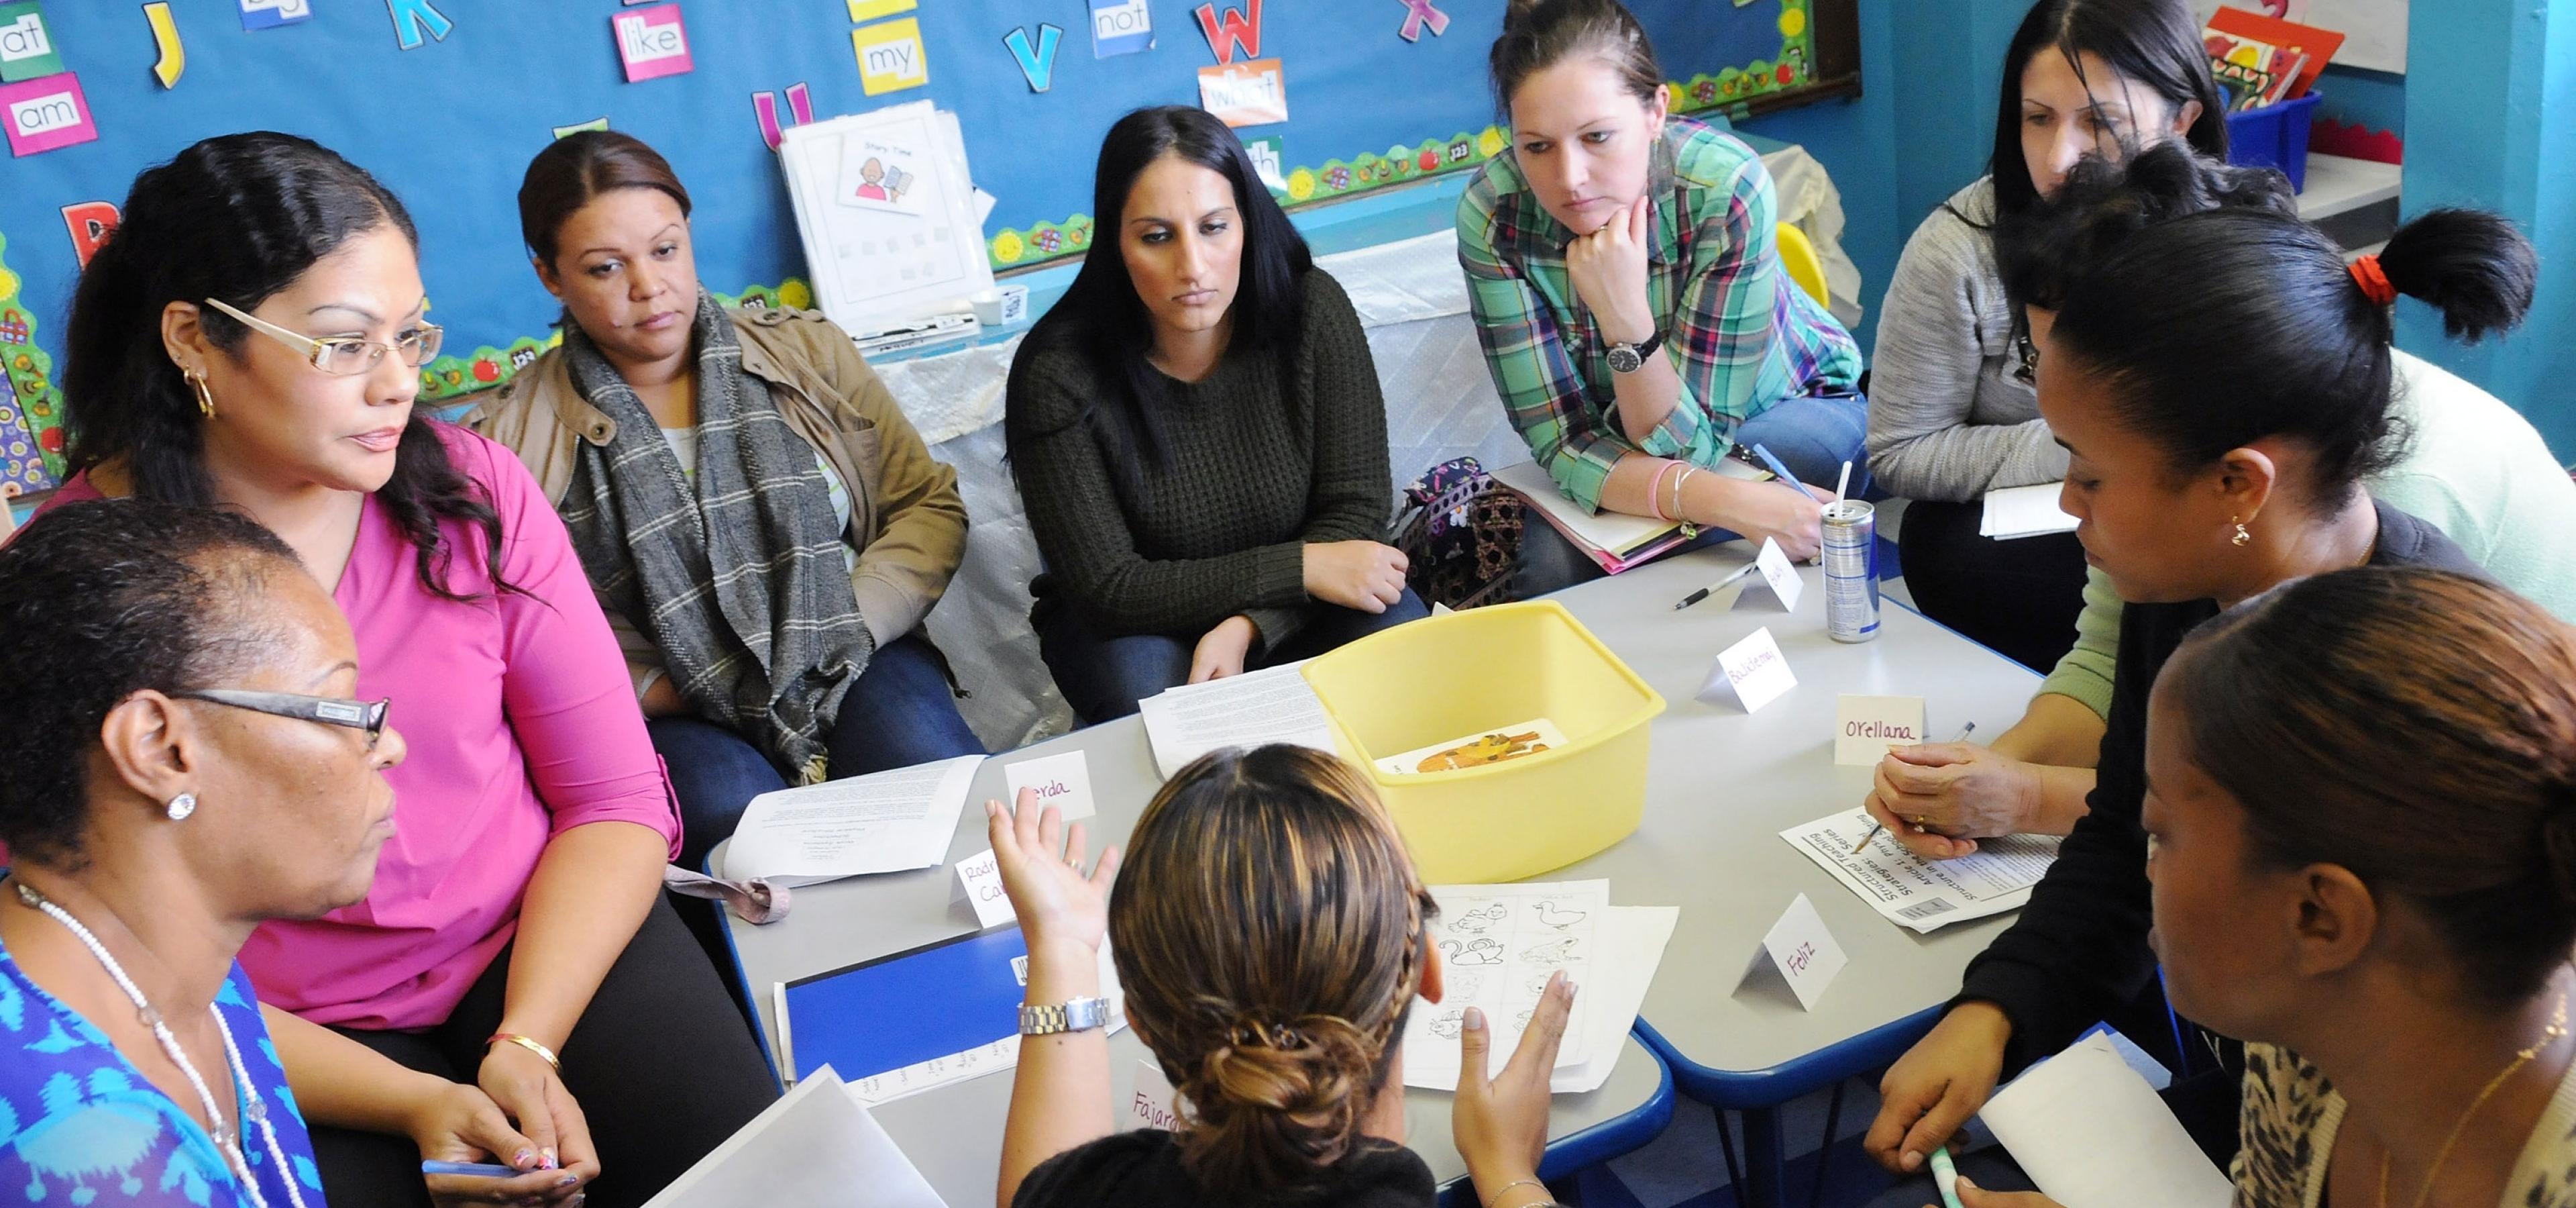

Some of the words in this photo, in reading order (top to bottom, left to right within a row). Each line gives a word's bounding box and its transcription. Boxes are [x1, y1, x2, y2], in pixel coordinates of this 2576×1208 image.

[1098, 4, 1144, 34] not
[1195, 0, 1262, 65] W
[3, 21, 39, 53] at
[142, 1, 186, 90] J
[623, 21, 677, 56] like
[869, 44, 912, 74] my
[1002, 22, 1064, 93] V
[1211, 71, 1275, 107] what
[19, 101, 74, 129] am
[1845, 720, 1917, 740] Orellana
[1809, 832, 1850, 864] Teaching
[1823, 828, 1854, 850] Series
[1846, 862, 1899, 901] Structured
[1862, 858, 1914, 897] Strategies:
[1903, 864, 1935, 886] Article
[1925, 864, 1938, 874] in
[1935, 872, 1978, 901] Structure
[1786, 941, 1816, 977] Feliz
